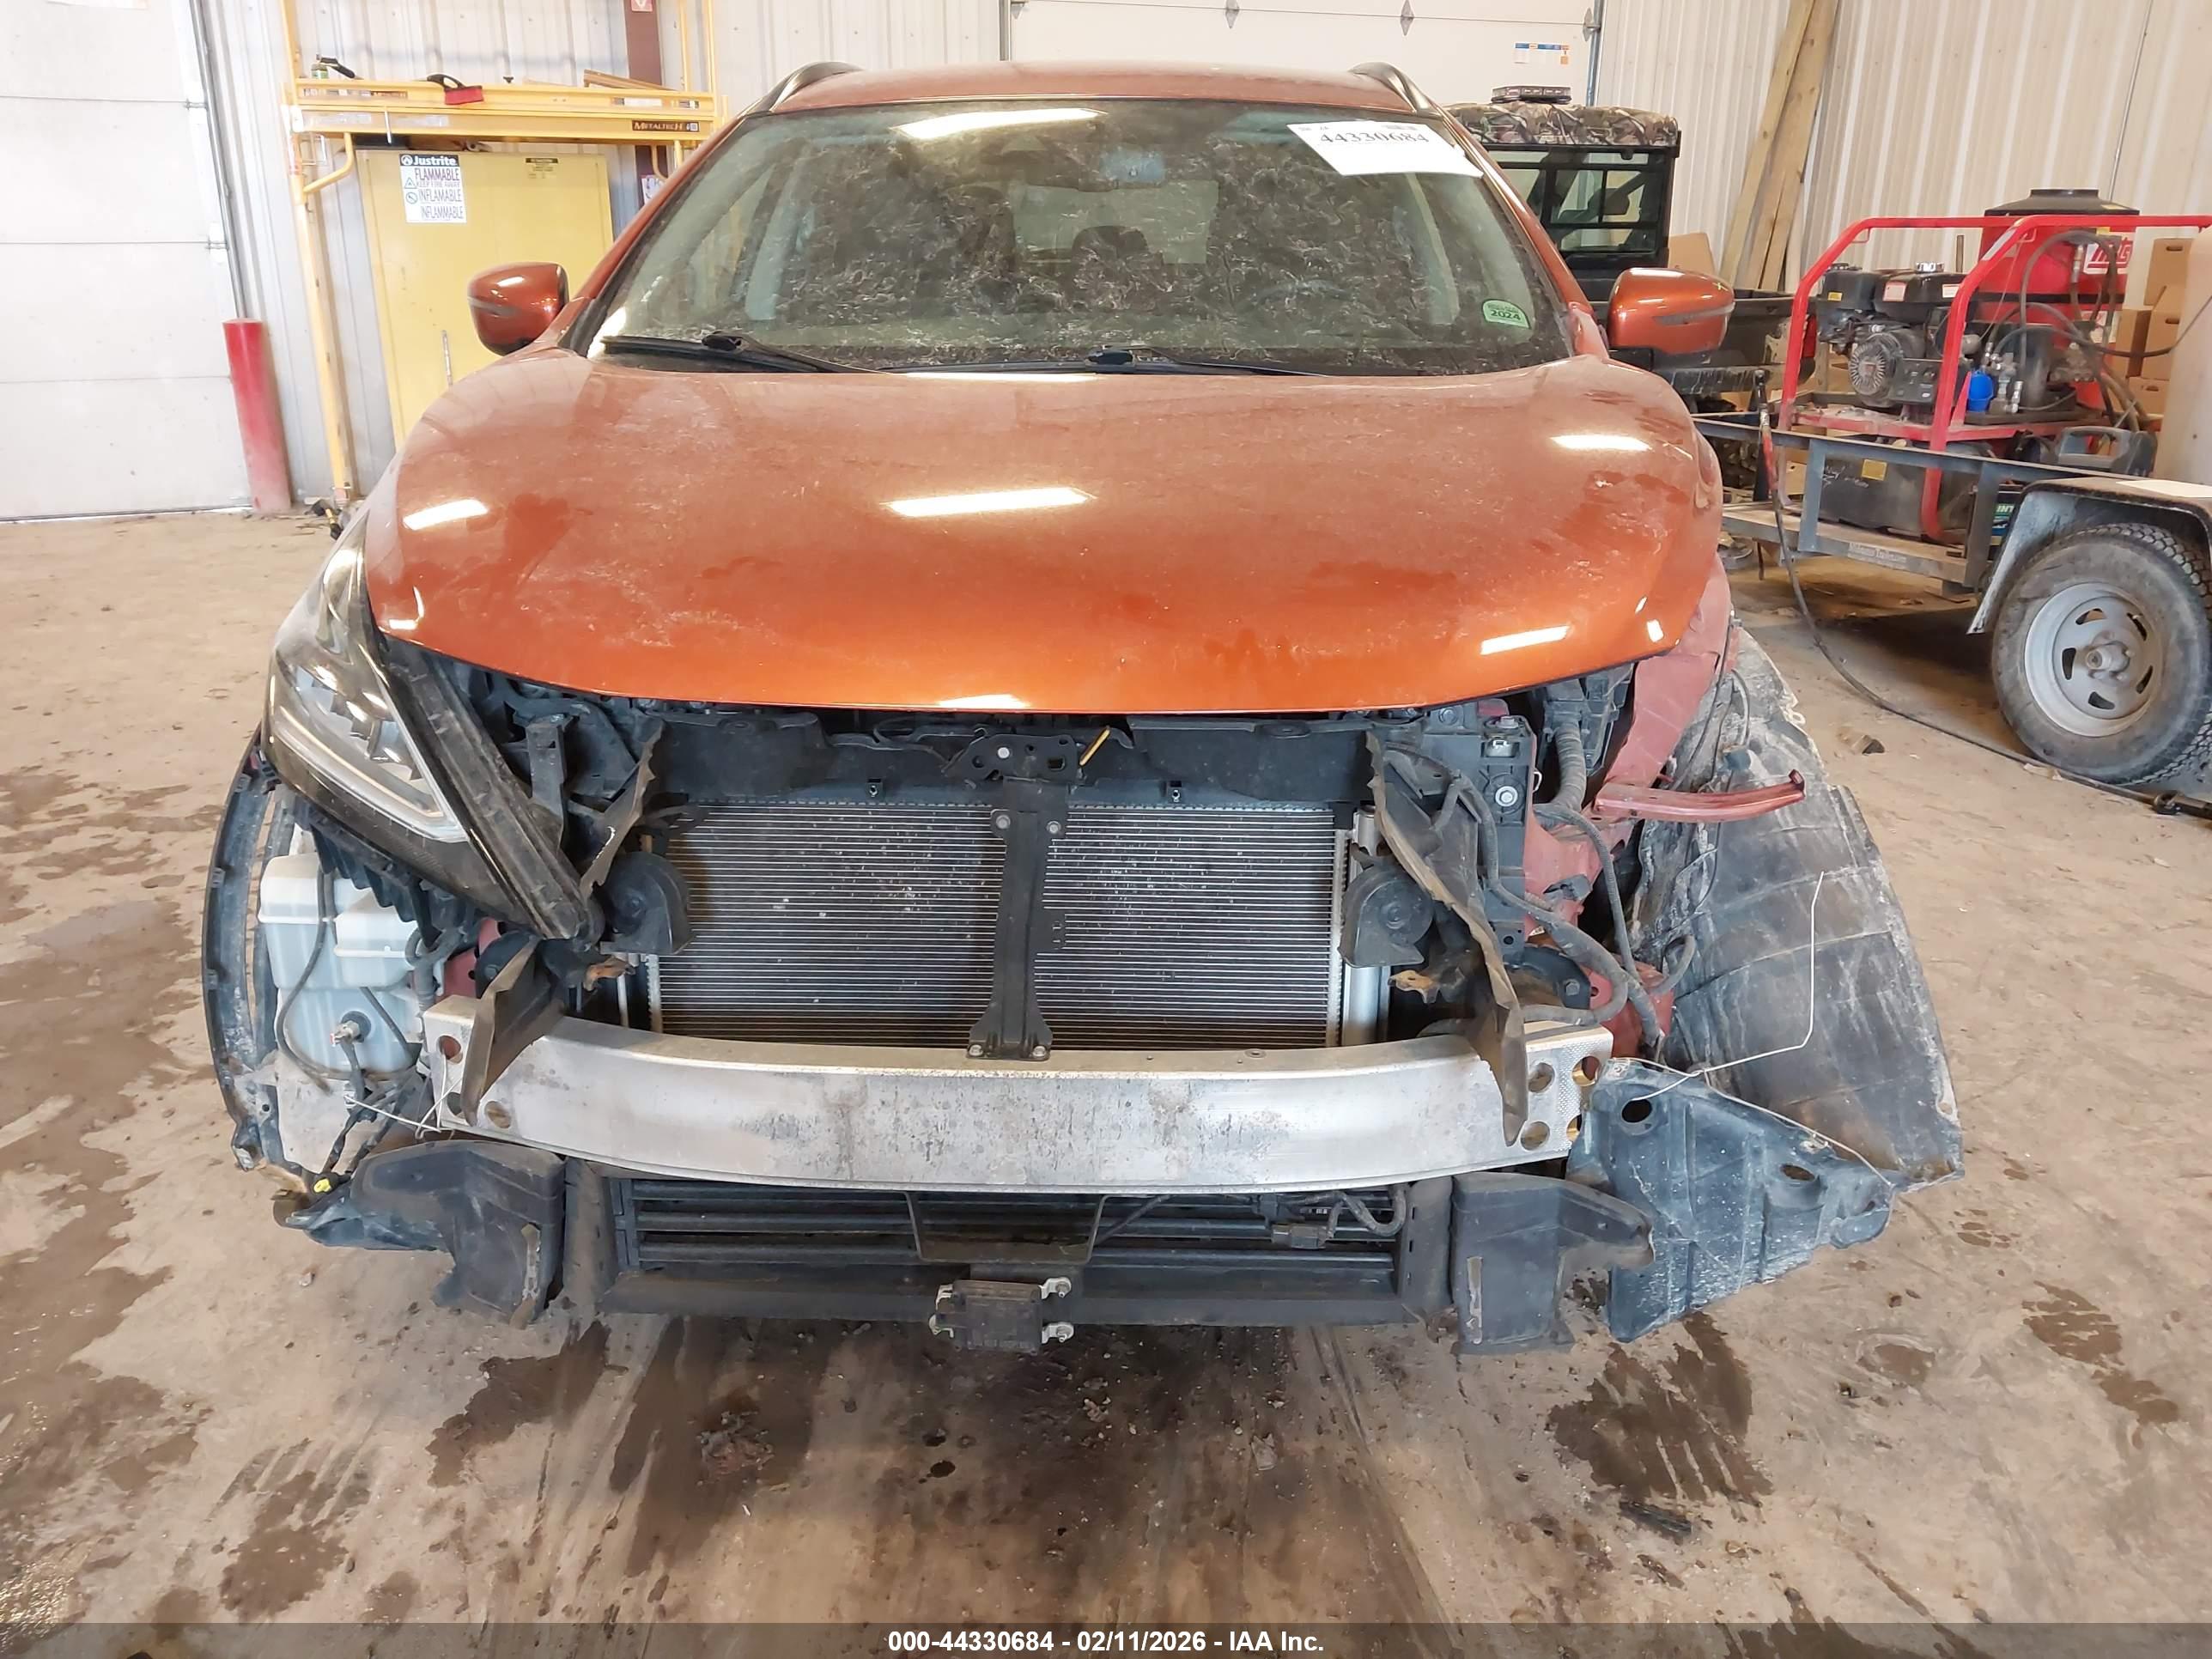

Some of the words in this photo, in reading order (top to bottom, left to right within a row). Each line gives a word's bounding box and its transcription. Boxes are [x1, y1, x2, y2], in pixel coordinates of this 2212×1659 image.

[1321, 132, 1430, 143] 44330684
[414, 155, 458, 166] Justrite
[415, 167, 460, 181] FLAMMABLE
[1490, 309, 1521, 320] 2024
